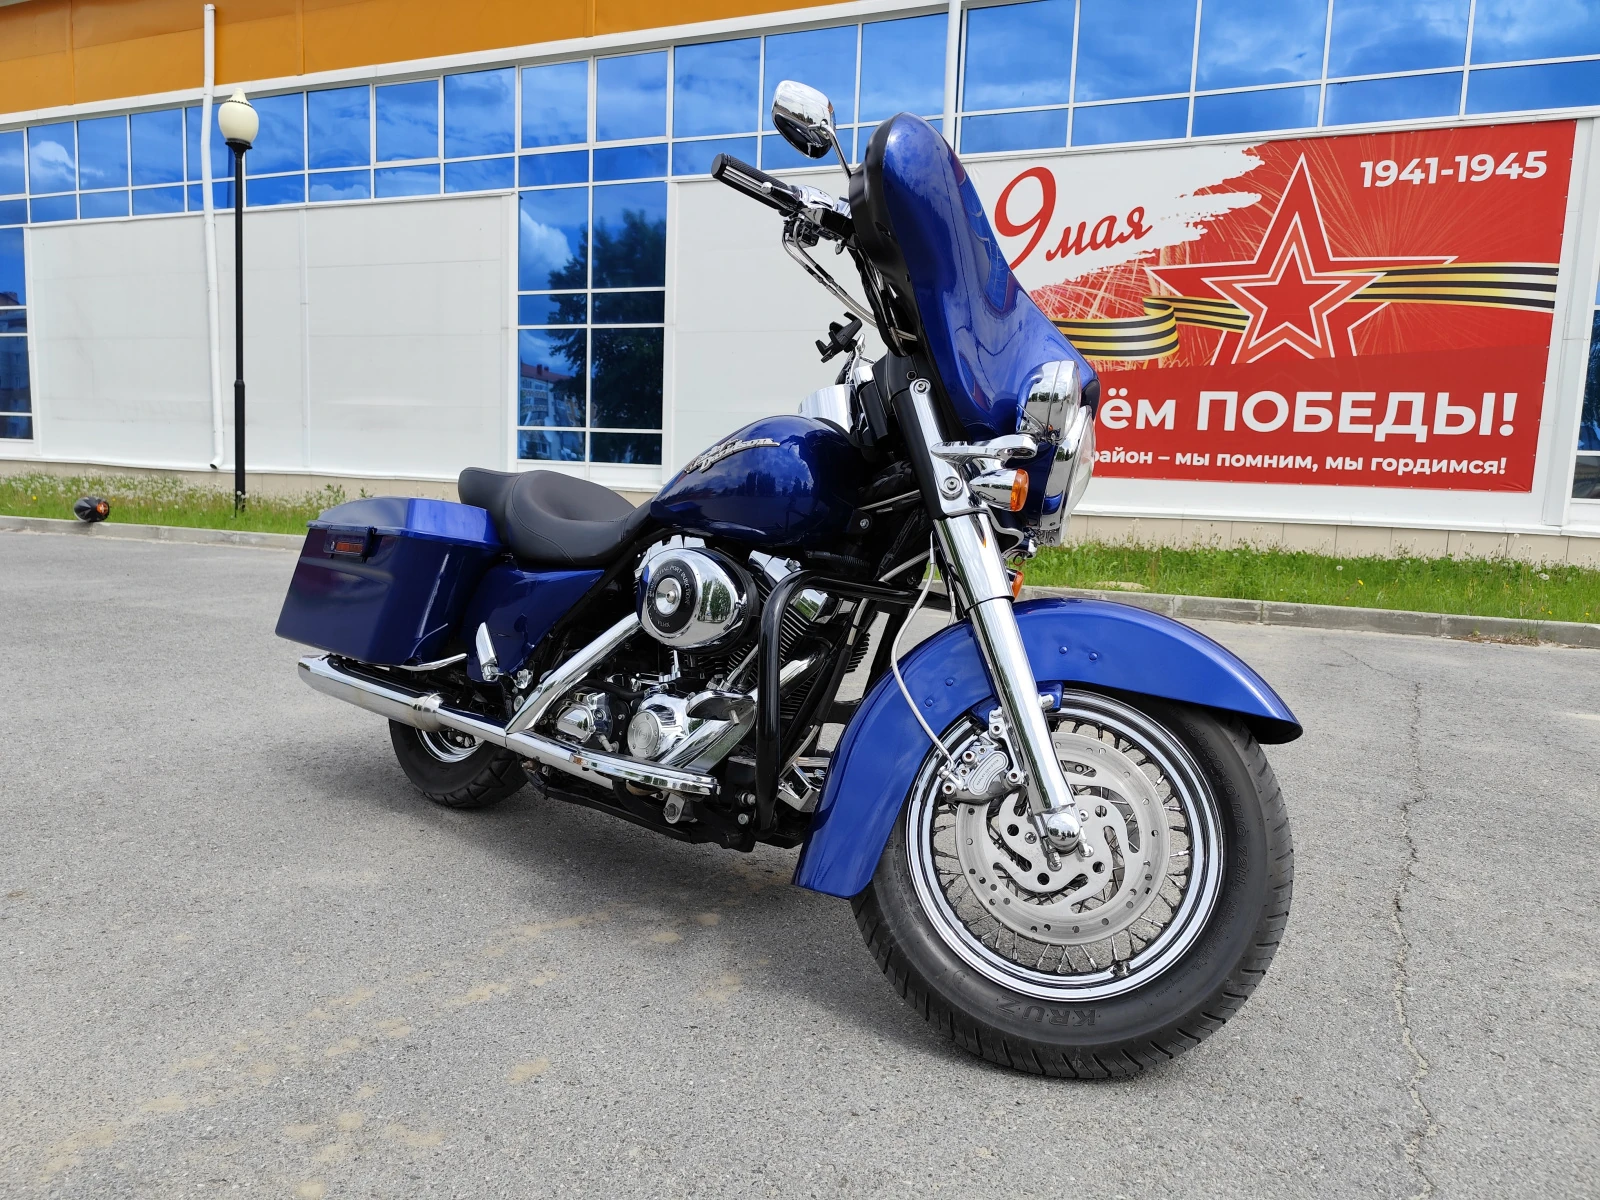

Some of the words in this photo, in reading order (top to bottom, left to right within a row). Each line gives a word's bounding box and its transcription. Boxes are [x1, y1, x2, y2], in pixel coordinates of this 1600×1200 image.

[1359, 150, 1548, 188] 1941-1945
[994, 166, 1057, 271] 9
[1045, 206, 1153, 262] мая
[1099, 387, 1177, 430] ём
[1196, 390, 1518, 443] ПОБЕДЫ!
[1175, 452, 1210, 467] мы
[1216, 453, 1319, 473] помним,
[1325, 456, 1364, 471] мы
[1370, 457, 1507, 476] гордимся!
[996, 995, 1098, 1027] KRUZ
